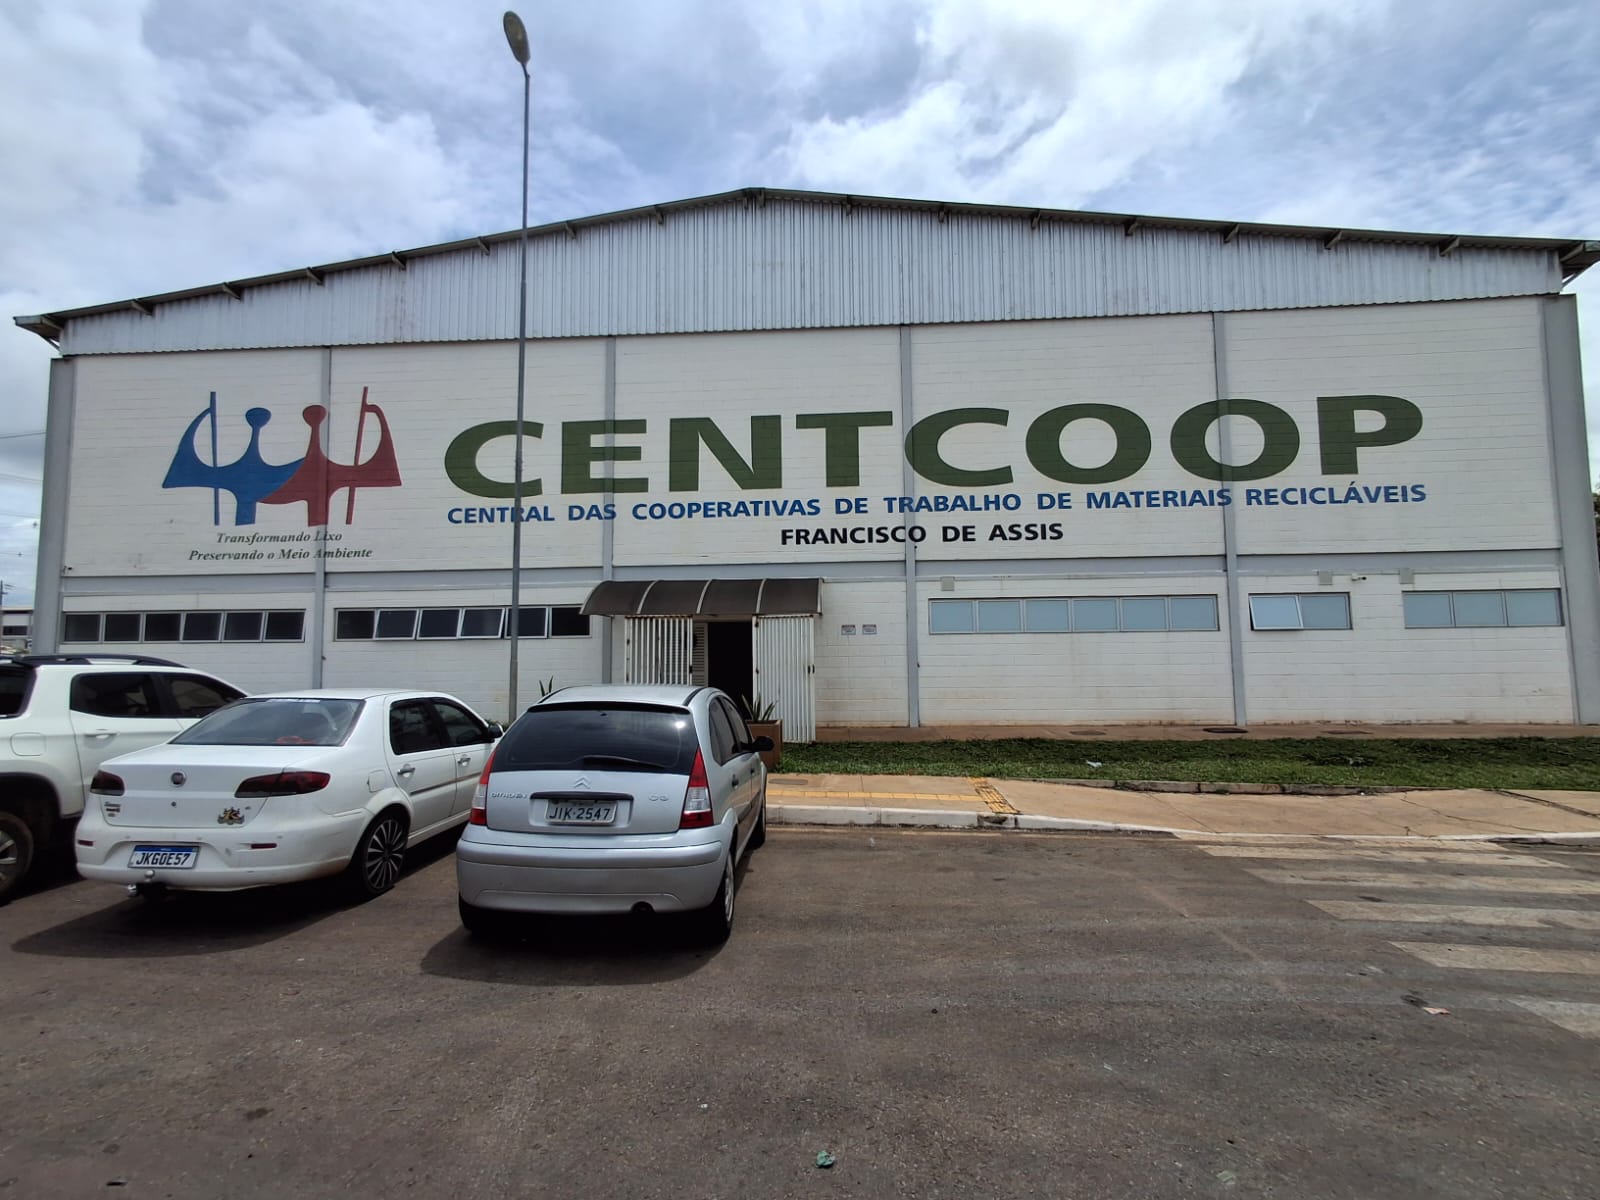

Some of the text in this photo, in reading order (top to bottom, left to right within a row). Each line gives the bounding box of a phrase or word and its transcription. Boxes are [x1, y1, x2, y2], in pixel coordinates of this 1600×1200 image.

[444, 395, 1423, 498] CENTCOOP
[448, 480, 1427, 524] CENTRAL DAS COOPERATIVAS DE TRABALHO DE MATERIAIS RECICLÁVEIS
[216, 531, 342, 545] Transformando Lixo
[781, 523, 1064, 545] FRANCISCO DE ASSIS
[188, 548, 373, 561] Preservando o Meio Ambiente
